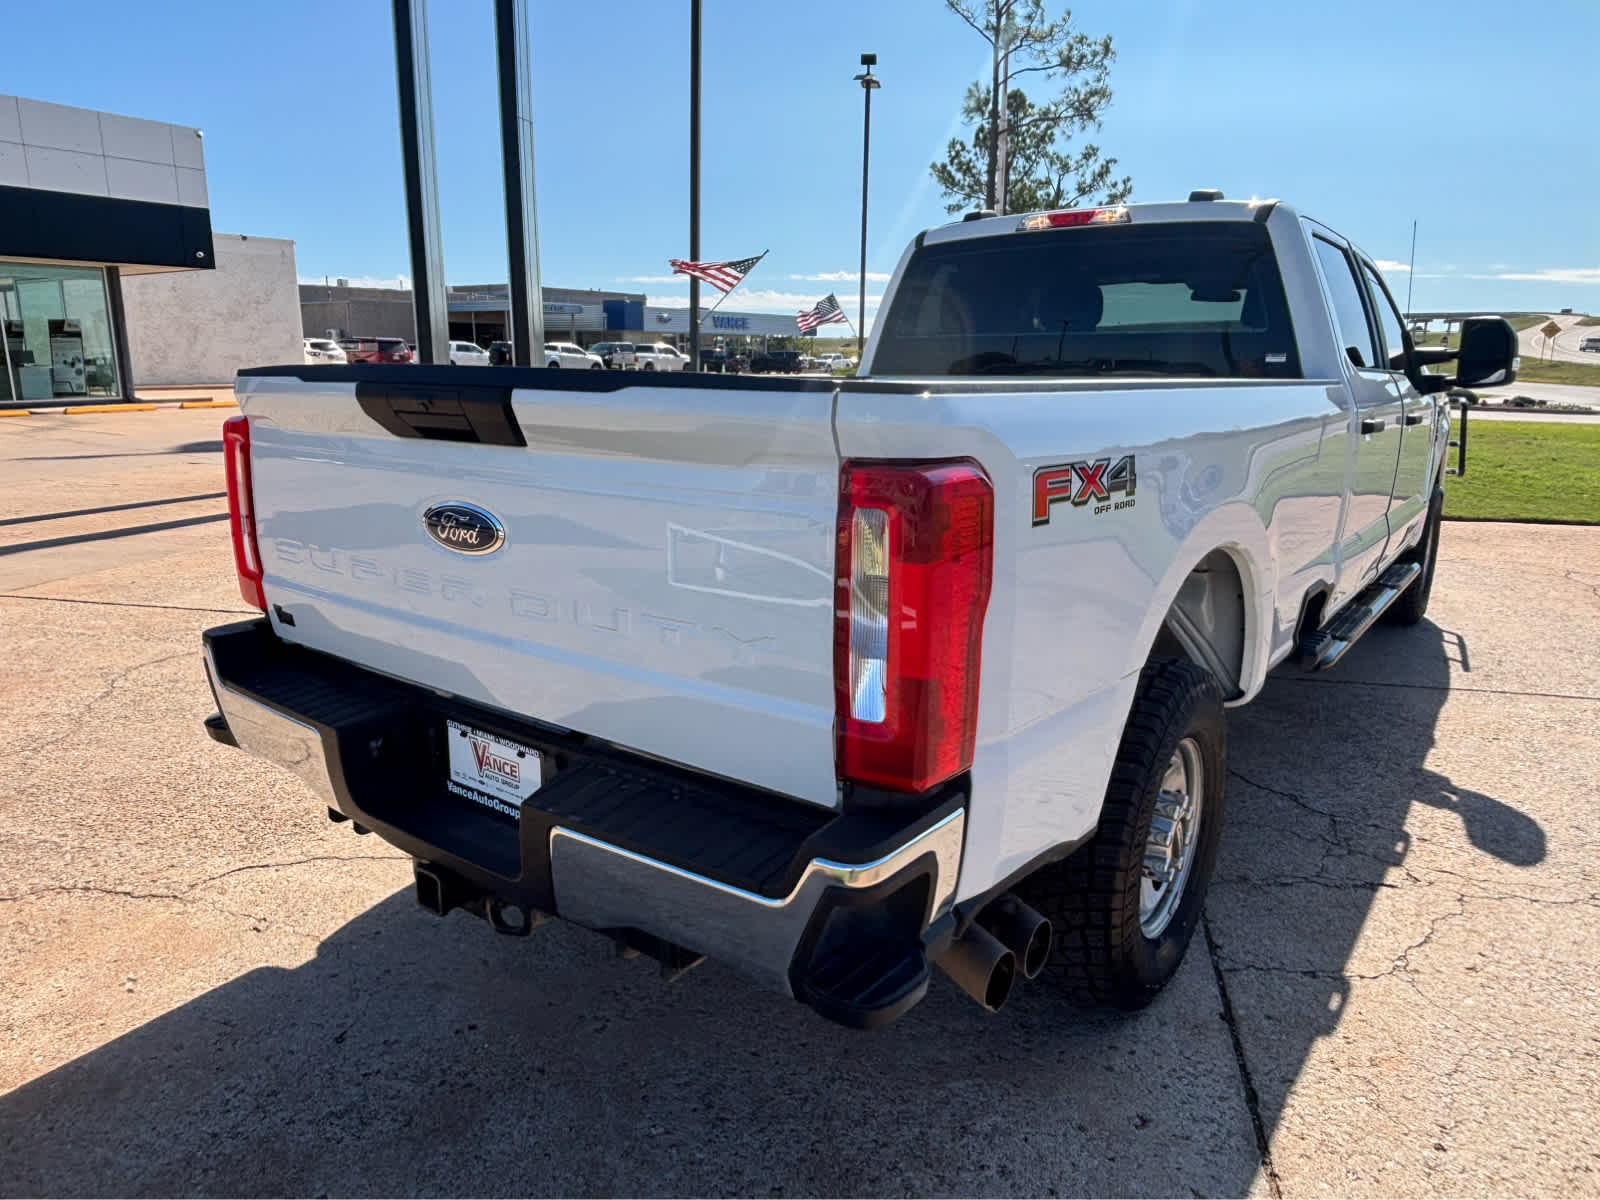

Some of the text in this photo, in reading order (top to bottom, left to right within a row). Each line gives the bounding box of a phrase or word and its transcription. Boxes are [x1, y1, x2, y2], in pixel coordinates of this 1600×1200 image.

[712, 315, 752, 329] VANCE
[1032, 455, 1136, 528] FX4
[1094, 499, 1136, 515] OFF ROAD
[437, 511, 481, 544] Ford
[273, 537, 777, 662] SUPER DUTY
[499, 737, 539, 758] WOODWARD
[485, 773, 499, 783] AUTO
